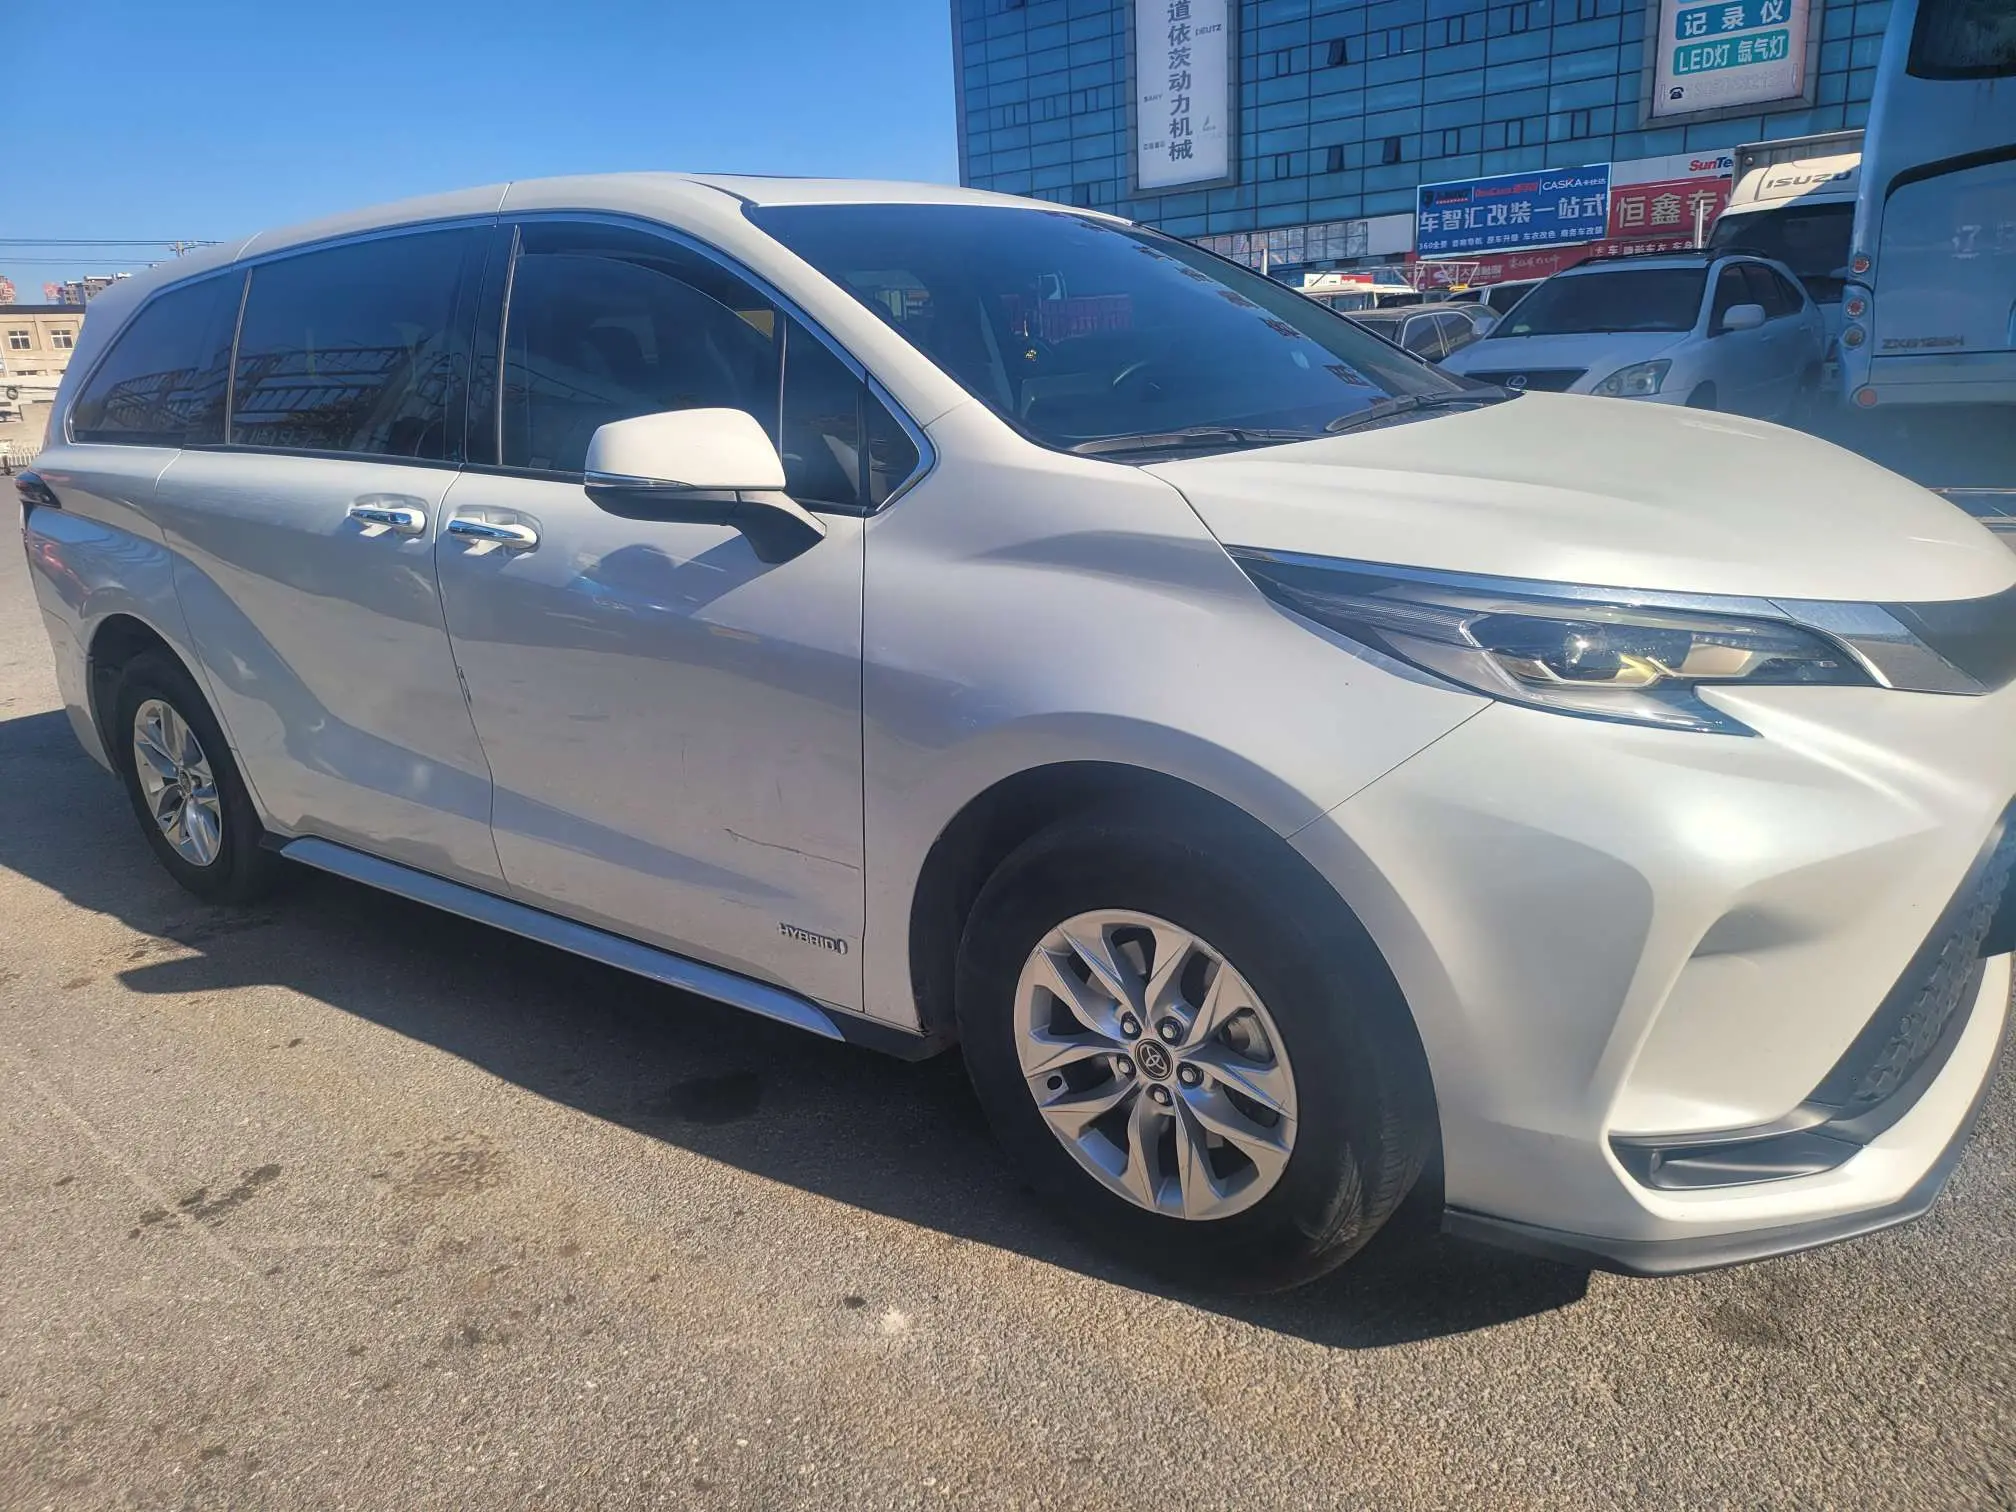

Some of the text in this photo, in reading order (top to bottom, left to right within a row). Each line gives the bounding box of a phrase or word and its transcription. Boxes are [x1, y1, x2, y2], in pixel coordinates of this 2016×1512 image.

[1684, 0, 1783, 36] 记录仪
[1679, 35, 1786, 72] LED灯 氙气灯
[1167, 0, 1193, 162] 道依茨动力机械
[1689, 156, 1734, 172] SunTe
[1766, 171, 1850, 188] ISUZU
[1542, 178, 1583, 191] CASKA
[1419, 193, 1606, 233] 车智汇改装一站式
[1616, 189, 1732, 229] 恒鑫专
